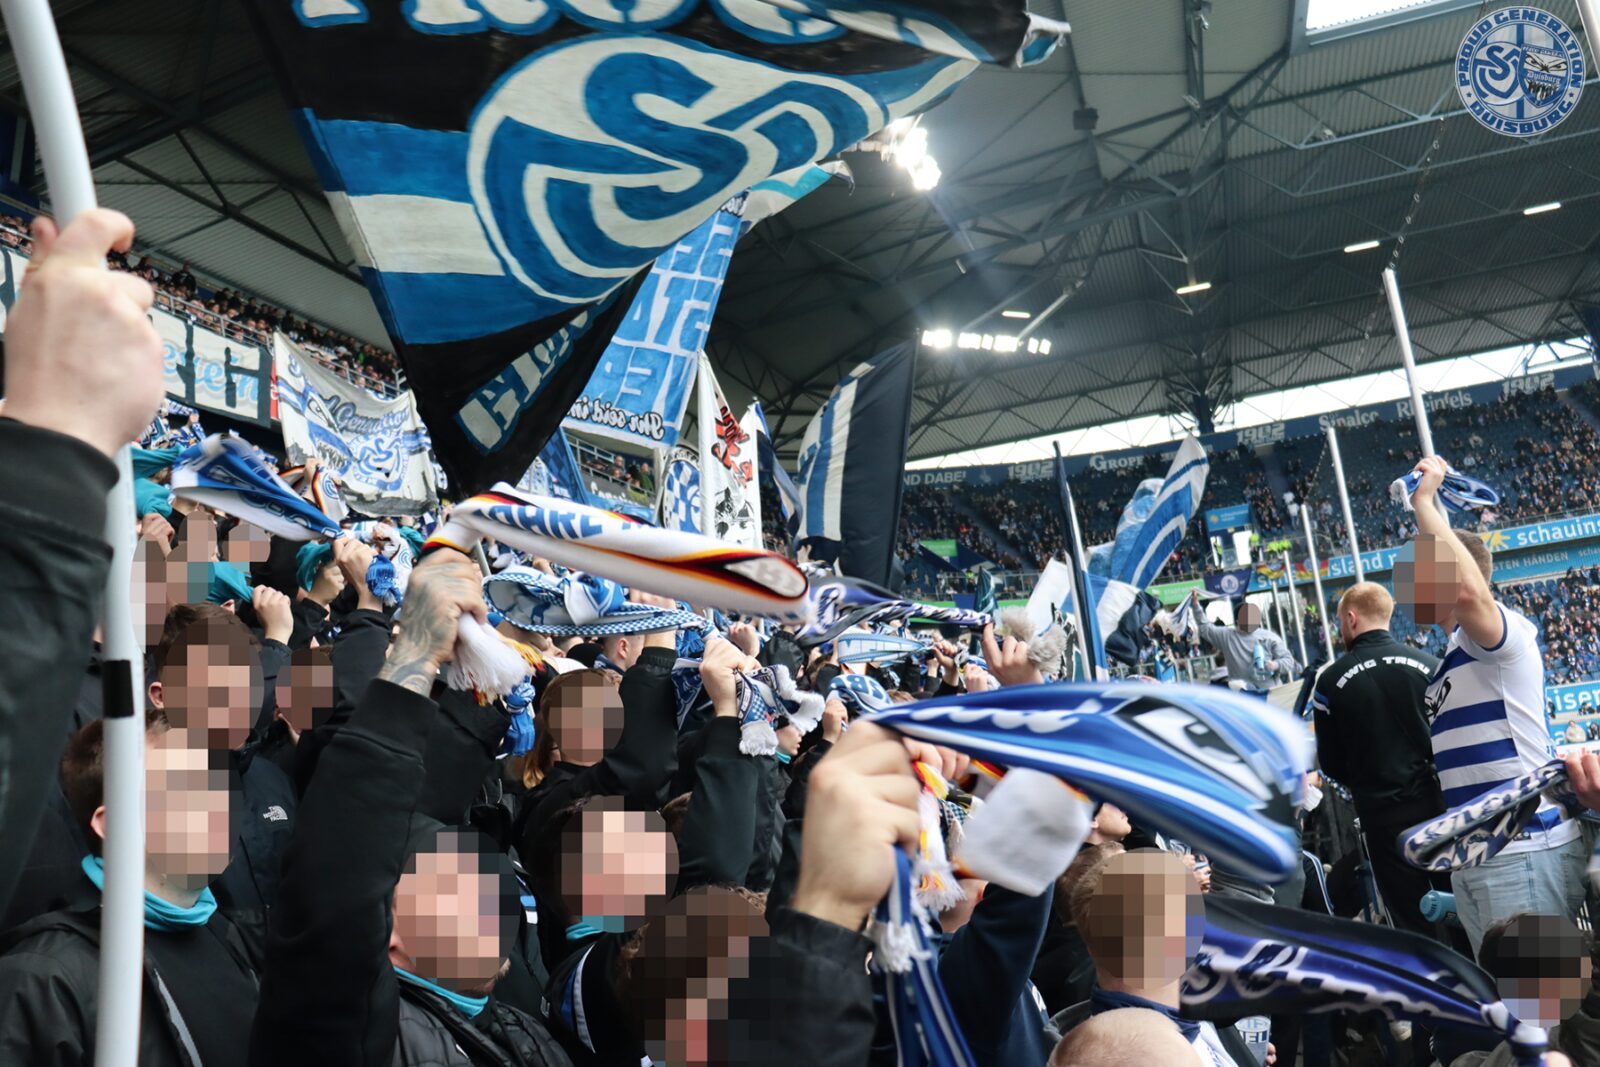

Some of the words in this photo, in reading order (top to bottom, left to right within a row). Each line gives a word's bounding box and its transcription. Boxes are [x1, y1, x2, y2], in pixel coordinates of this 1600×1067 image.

[1318, 409, 1379, 432] Sinalco
[1236, 423, 1284, 446] 1902
[1007, 461, 1054, 481] 1902
[1336, 659, 1377, 689] EWIG
[1382, 656, 1431, 676] TREU
